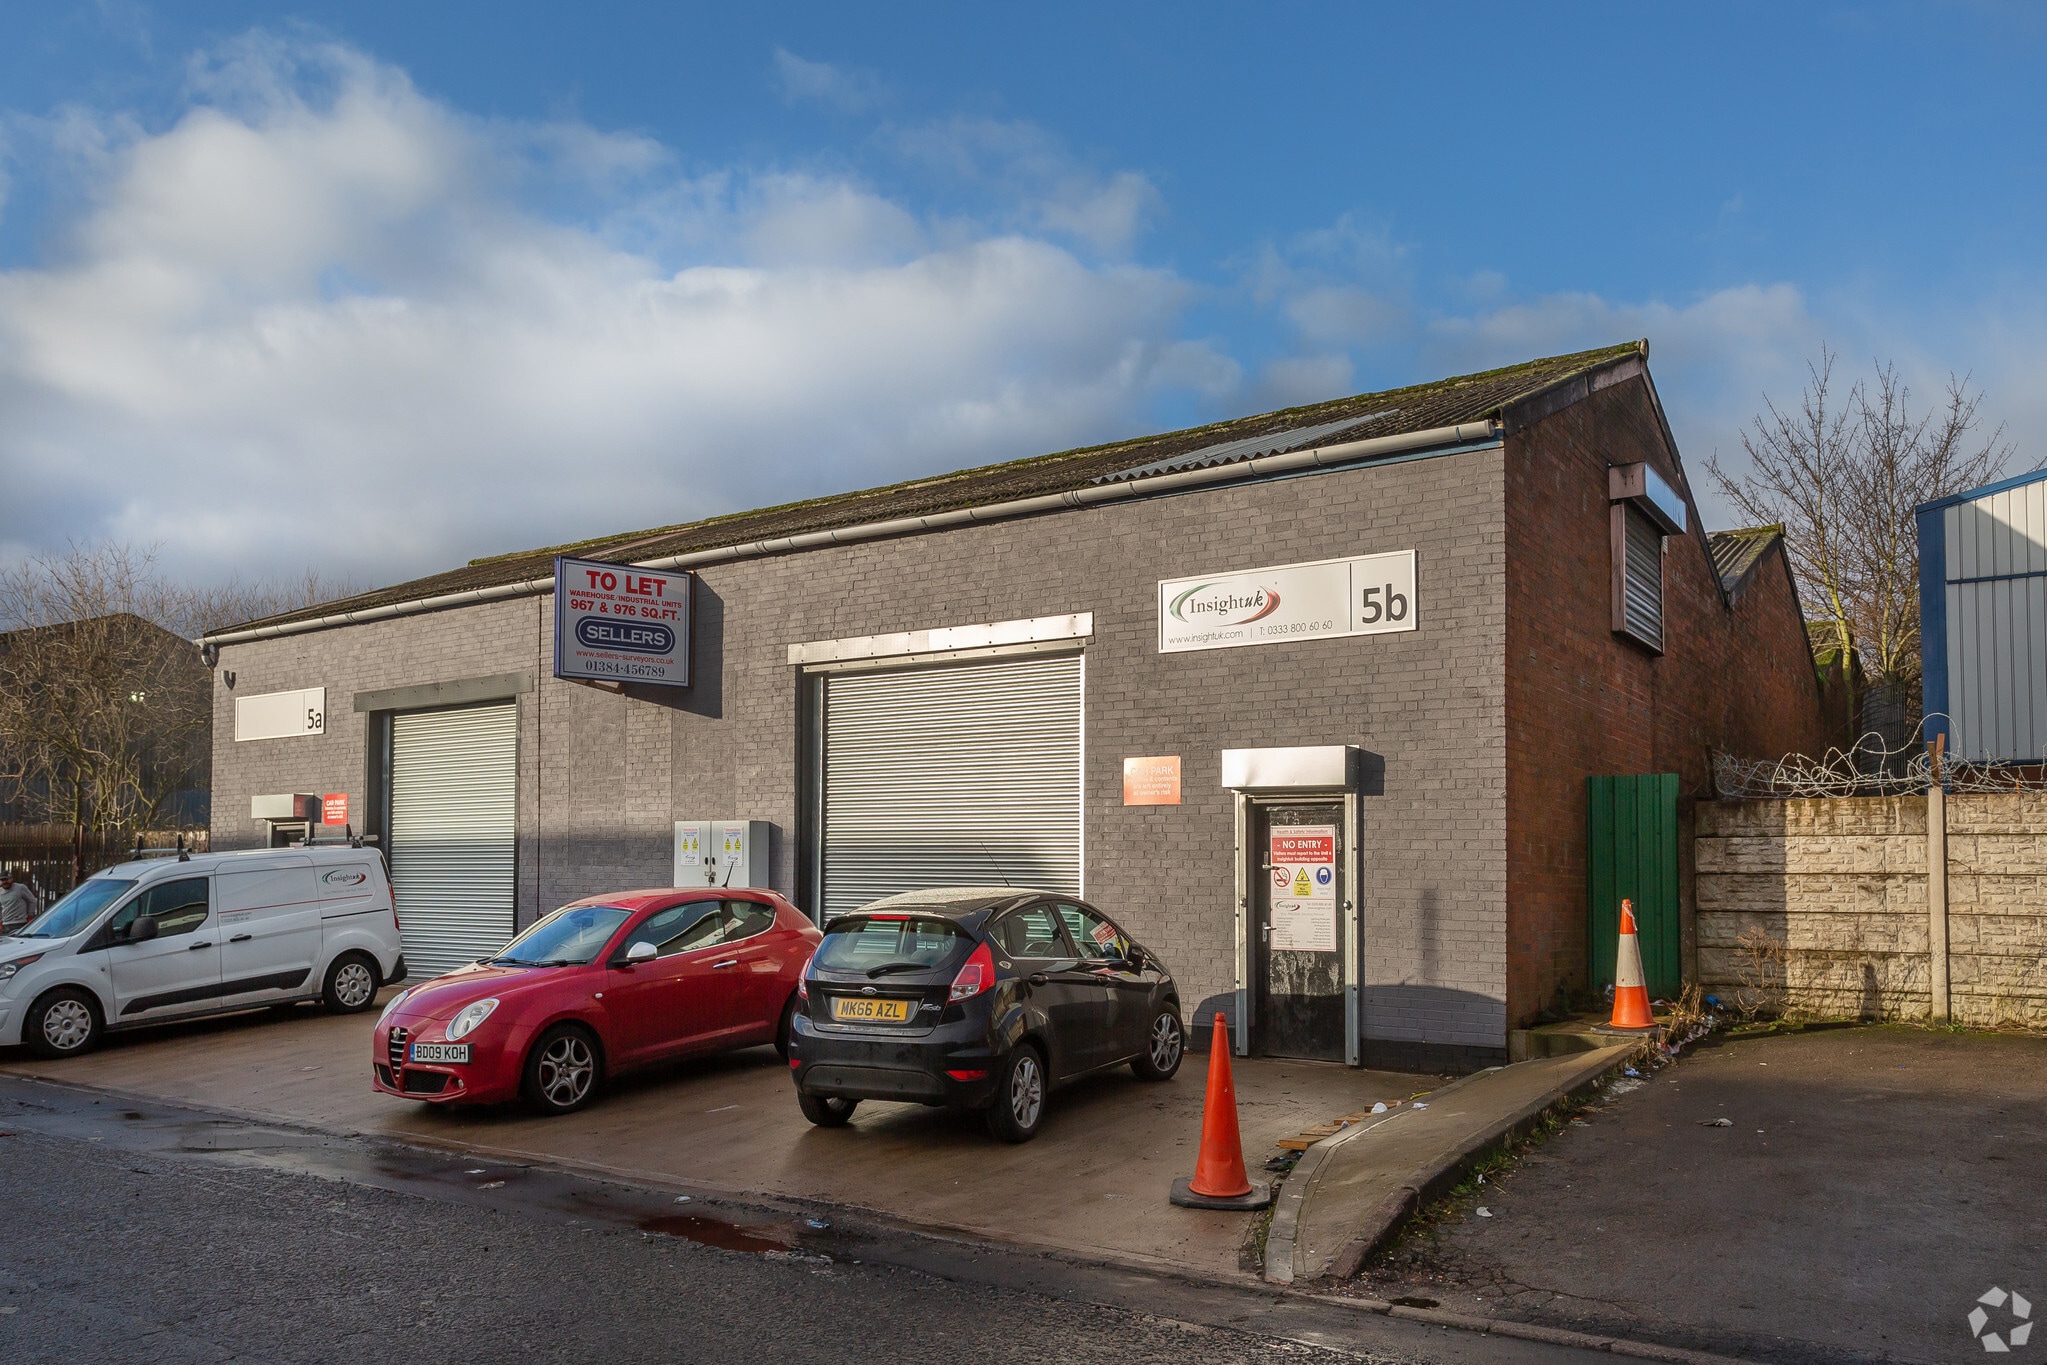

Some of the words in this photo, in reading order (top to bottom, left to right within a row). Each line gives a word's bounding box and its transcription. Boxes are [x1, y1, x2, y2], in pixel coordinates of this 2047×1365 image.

[586, 570, 617, 591] TO
[626, 575, 667, 597] LET
[570, 599, 595, 611] 967
[599, 602, 608, 613] &
[613, 603, 637, 616] 976
[641, 607, 681, 621] SQ.FT.
[662, 600, 682, 609] UNITS
[1190, 590, 1264, 616] Insightuk
[1362, 583, 1408, 624] 5b
[586, 625, 666, 646] SELLERS
[1168, 629, 1244, 645] www.insightuk.com
[1259, 626, 1266, 636] T:
[1267, 624, 1289, 635] 0333
[1290, 622, 1307, 633] 800
[1309, 621, 1320, 631] 60
[1322, 619, 1333, 630] 60
[576, 650, 675, 665] www.sellers-surveyors.co.uk
[307, 708, 322, 729] 5a
[1151, 766, 1174, 775] PARK
[1282, 840, 1296, 849] NO
[1297, 840, 1322, 849] ENTRY
[841, 1001, 874, 1016] MK66
[876, 1002, 900, 1018] AZL
[416, 1045, 441, 1059] BD09
[444, 1046, 467, 1060] KOH
